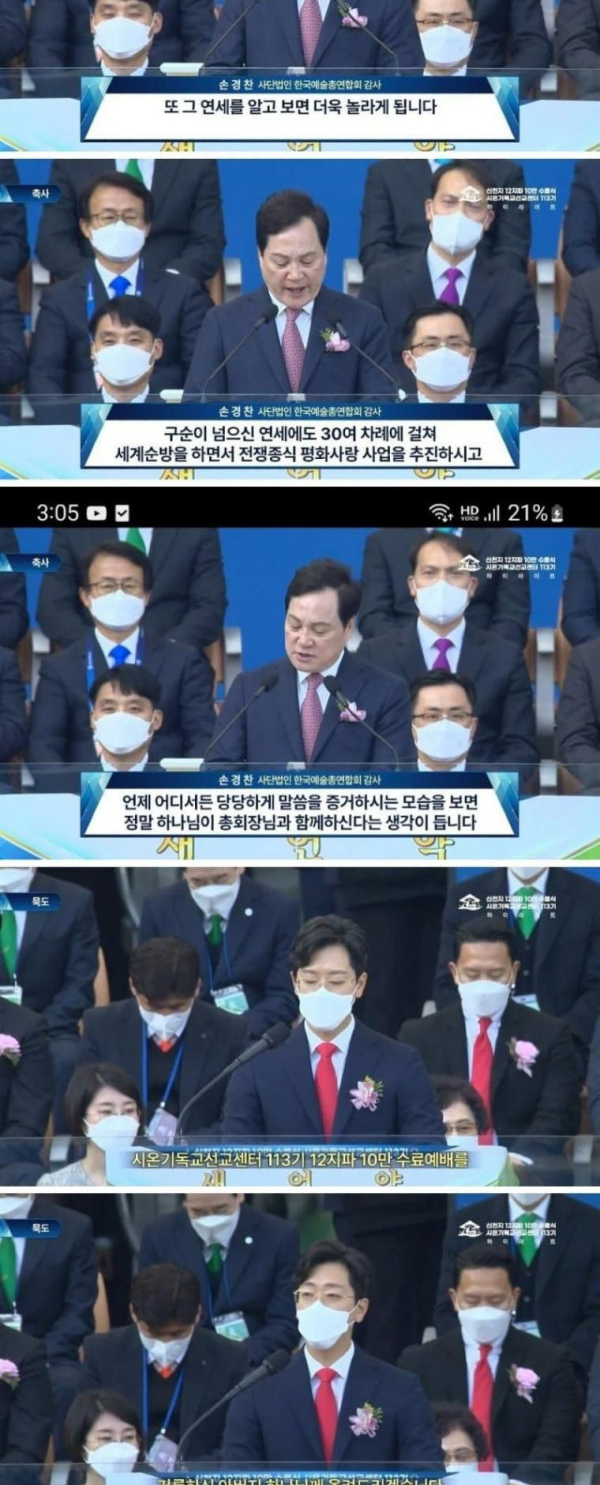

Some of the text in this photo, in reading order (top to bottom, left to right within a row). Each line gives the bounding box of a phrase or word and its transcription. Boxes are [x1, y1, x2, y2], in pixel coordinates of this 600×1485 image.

[36, 504, 79, 522] 3:05
[460, 505, 479, 515] HD
[508, 503, 548, 522] 21%
